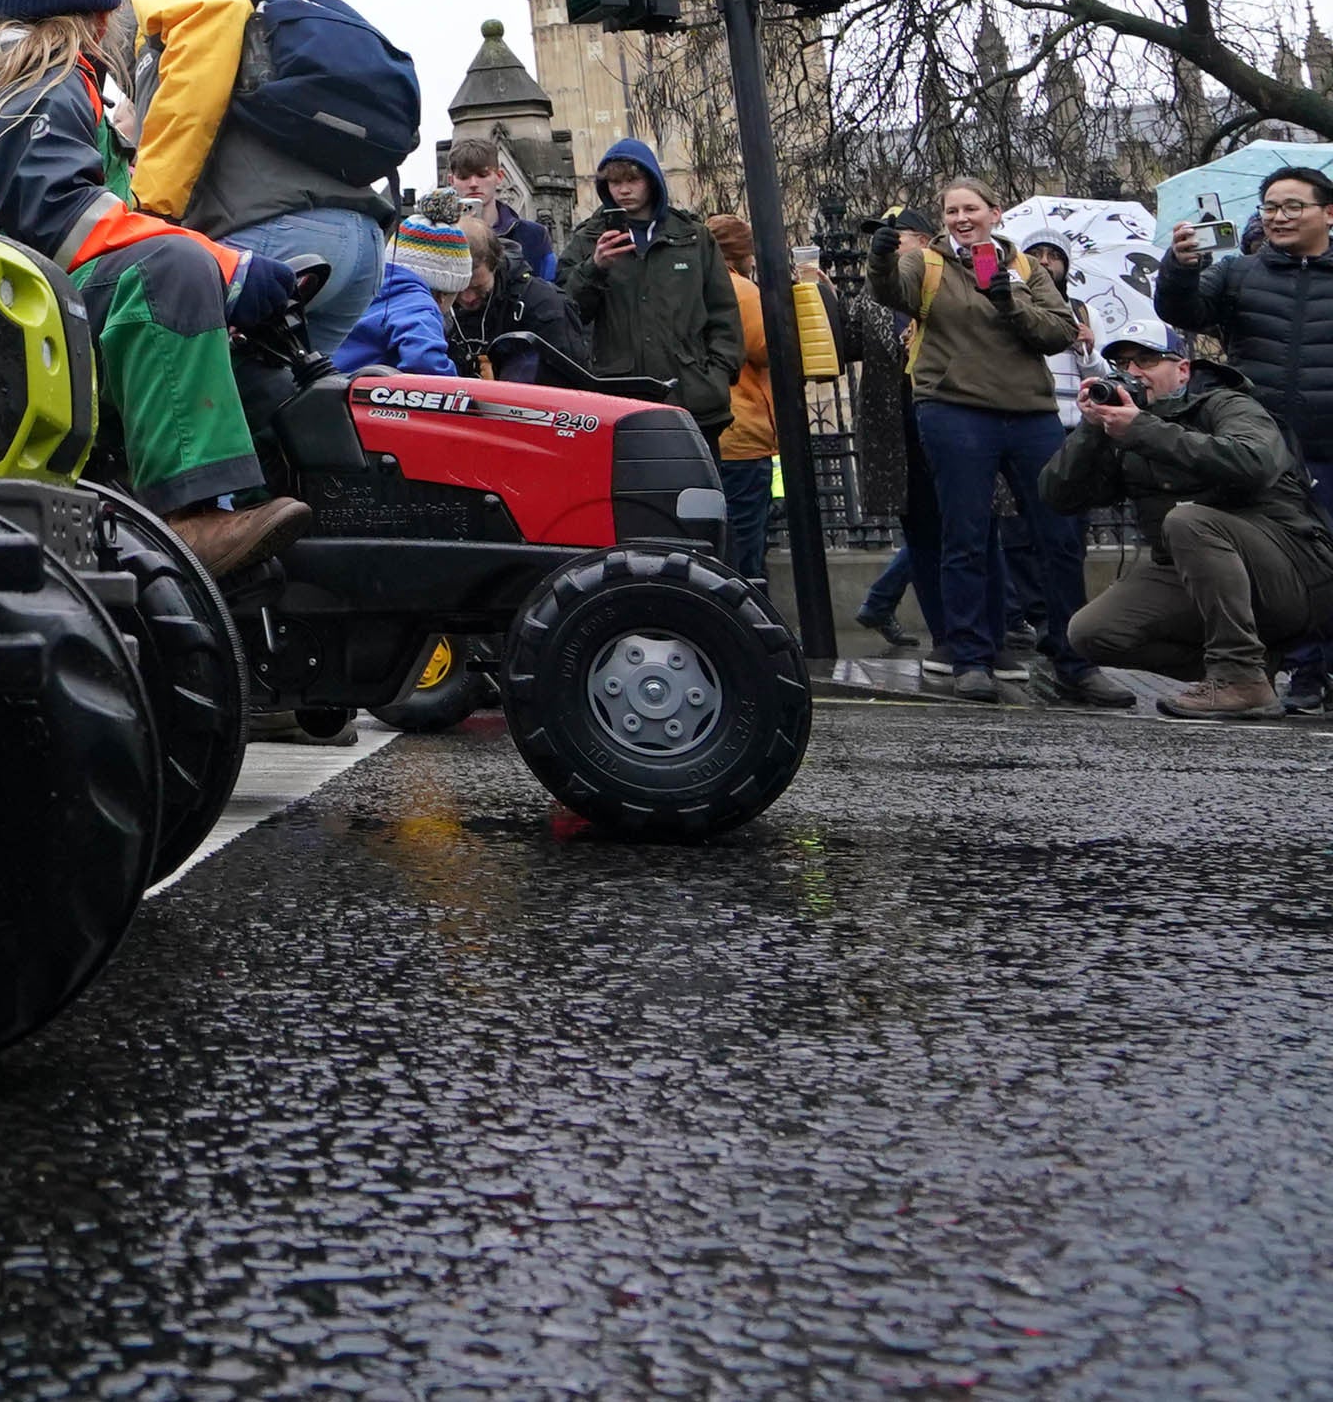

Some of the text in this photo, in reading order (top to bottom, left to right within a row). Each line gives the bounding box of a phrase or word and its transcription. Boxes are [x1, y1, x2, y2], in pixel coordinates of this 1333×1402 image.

[370, 387, 443, 409] CASE
[370, 409, 407, 419] PUMA
[554, 411, 599, 433] 240
